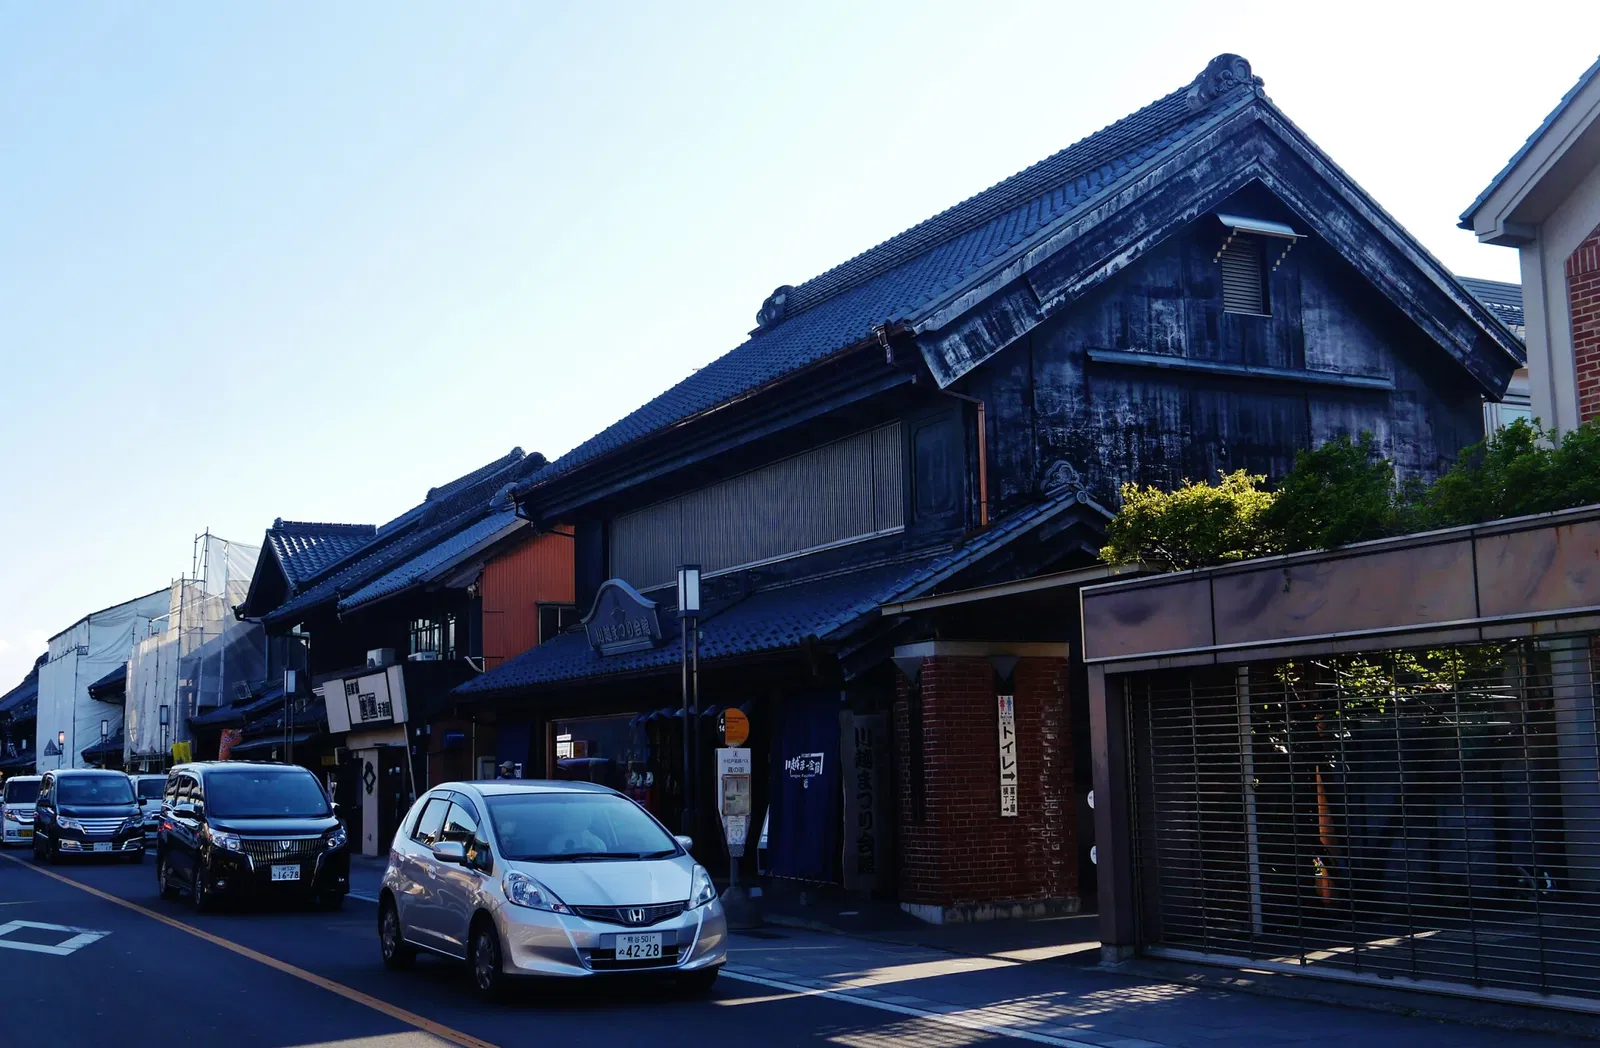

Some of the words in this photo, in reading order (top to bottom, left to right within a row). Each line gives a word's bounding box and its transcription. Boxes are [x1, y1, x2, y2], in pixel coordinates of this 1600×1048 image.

[595, 616, 651, 643] 川越まつり会館
[1001, 726, 1015, 770] トイレ
[278, 871, 299, 880] 16-78
[626, 944, 660, 958] 42-28
